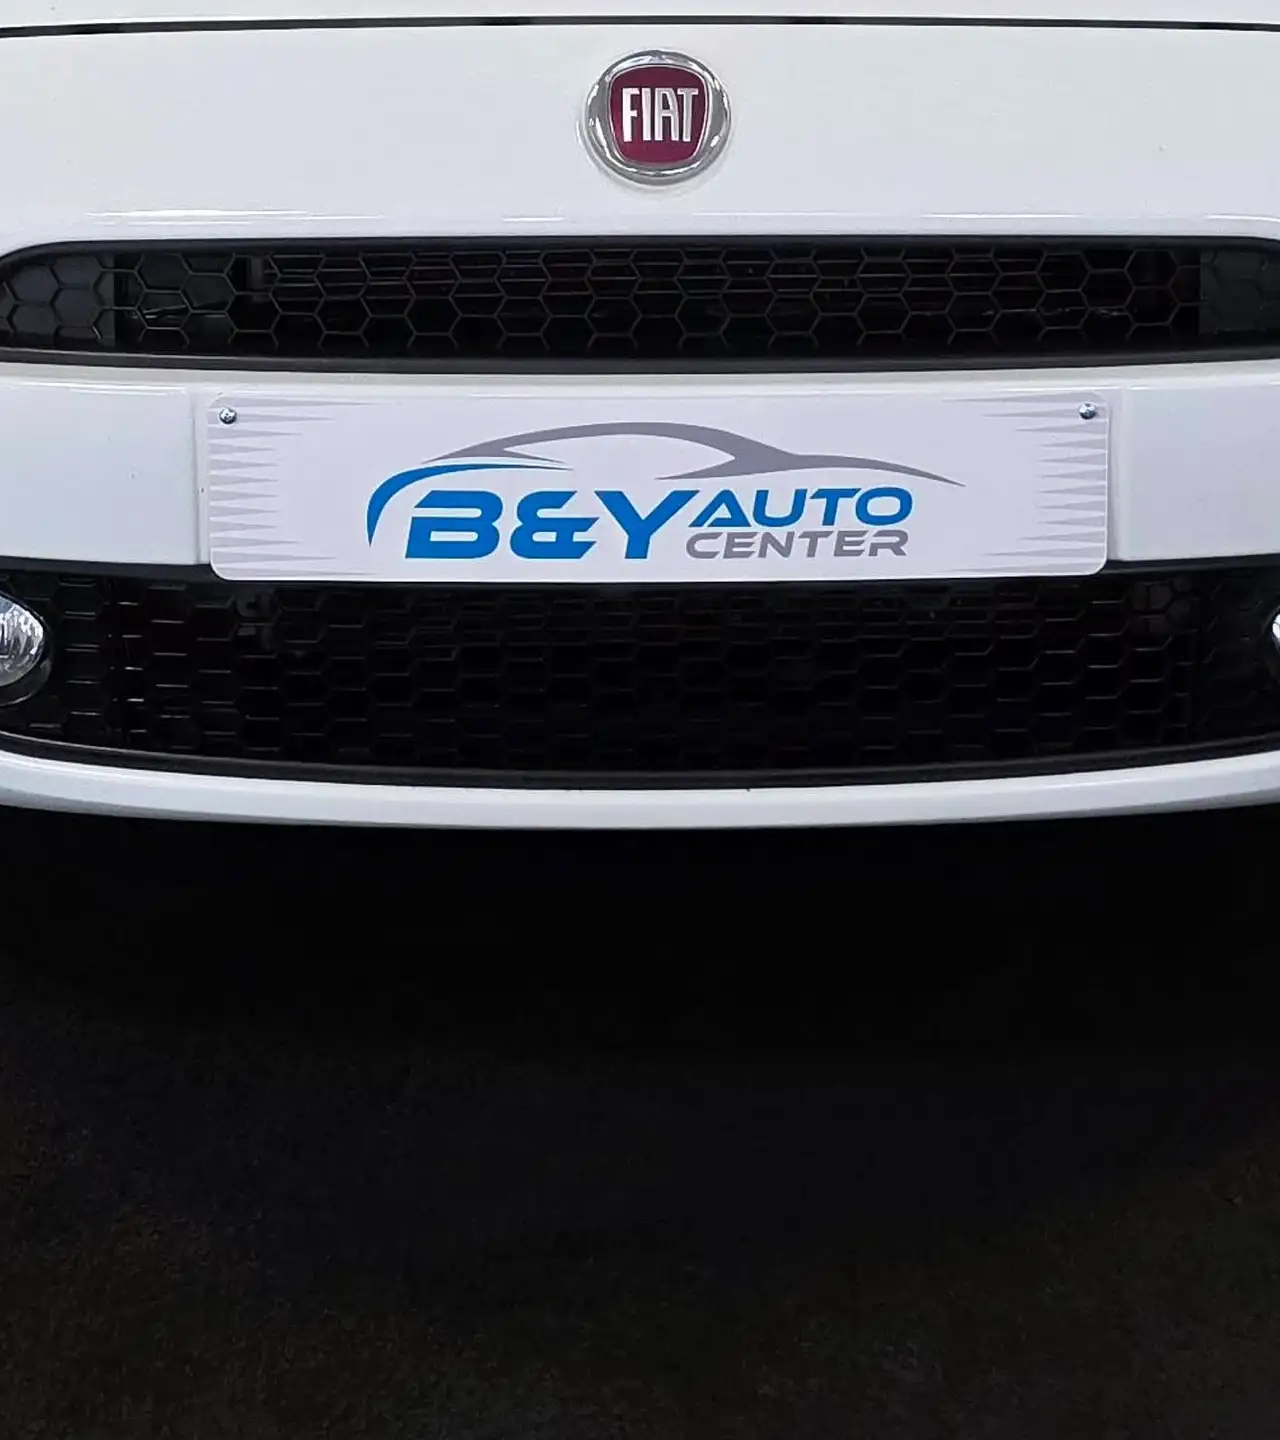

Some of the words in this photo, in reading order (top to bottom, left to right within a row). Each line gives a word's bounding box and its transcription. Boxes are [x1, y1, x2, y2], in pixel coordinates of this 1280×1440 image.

[622, 87, 699, 143] FIAT
[405, 489, 700, 560] B&Y
[687, 486, 913, 528] AUTO
[685, 529, 910, 560] CENTER
